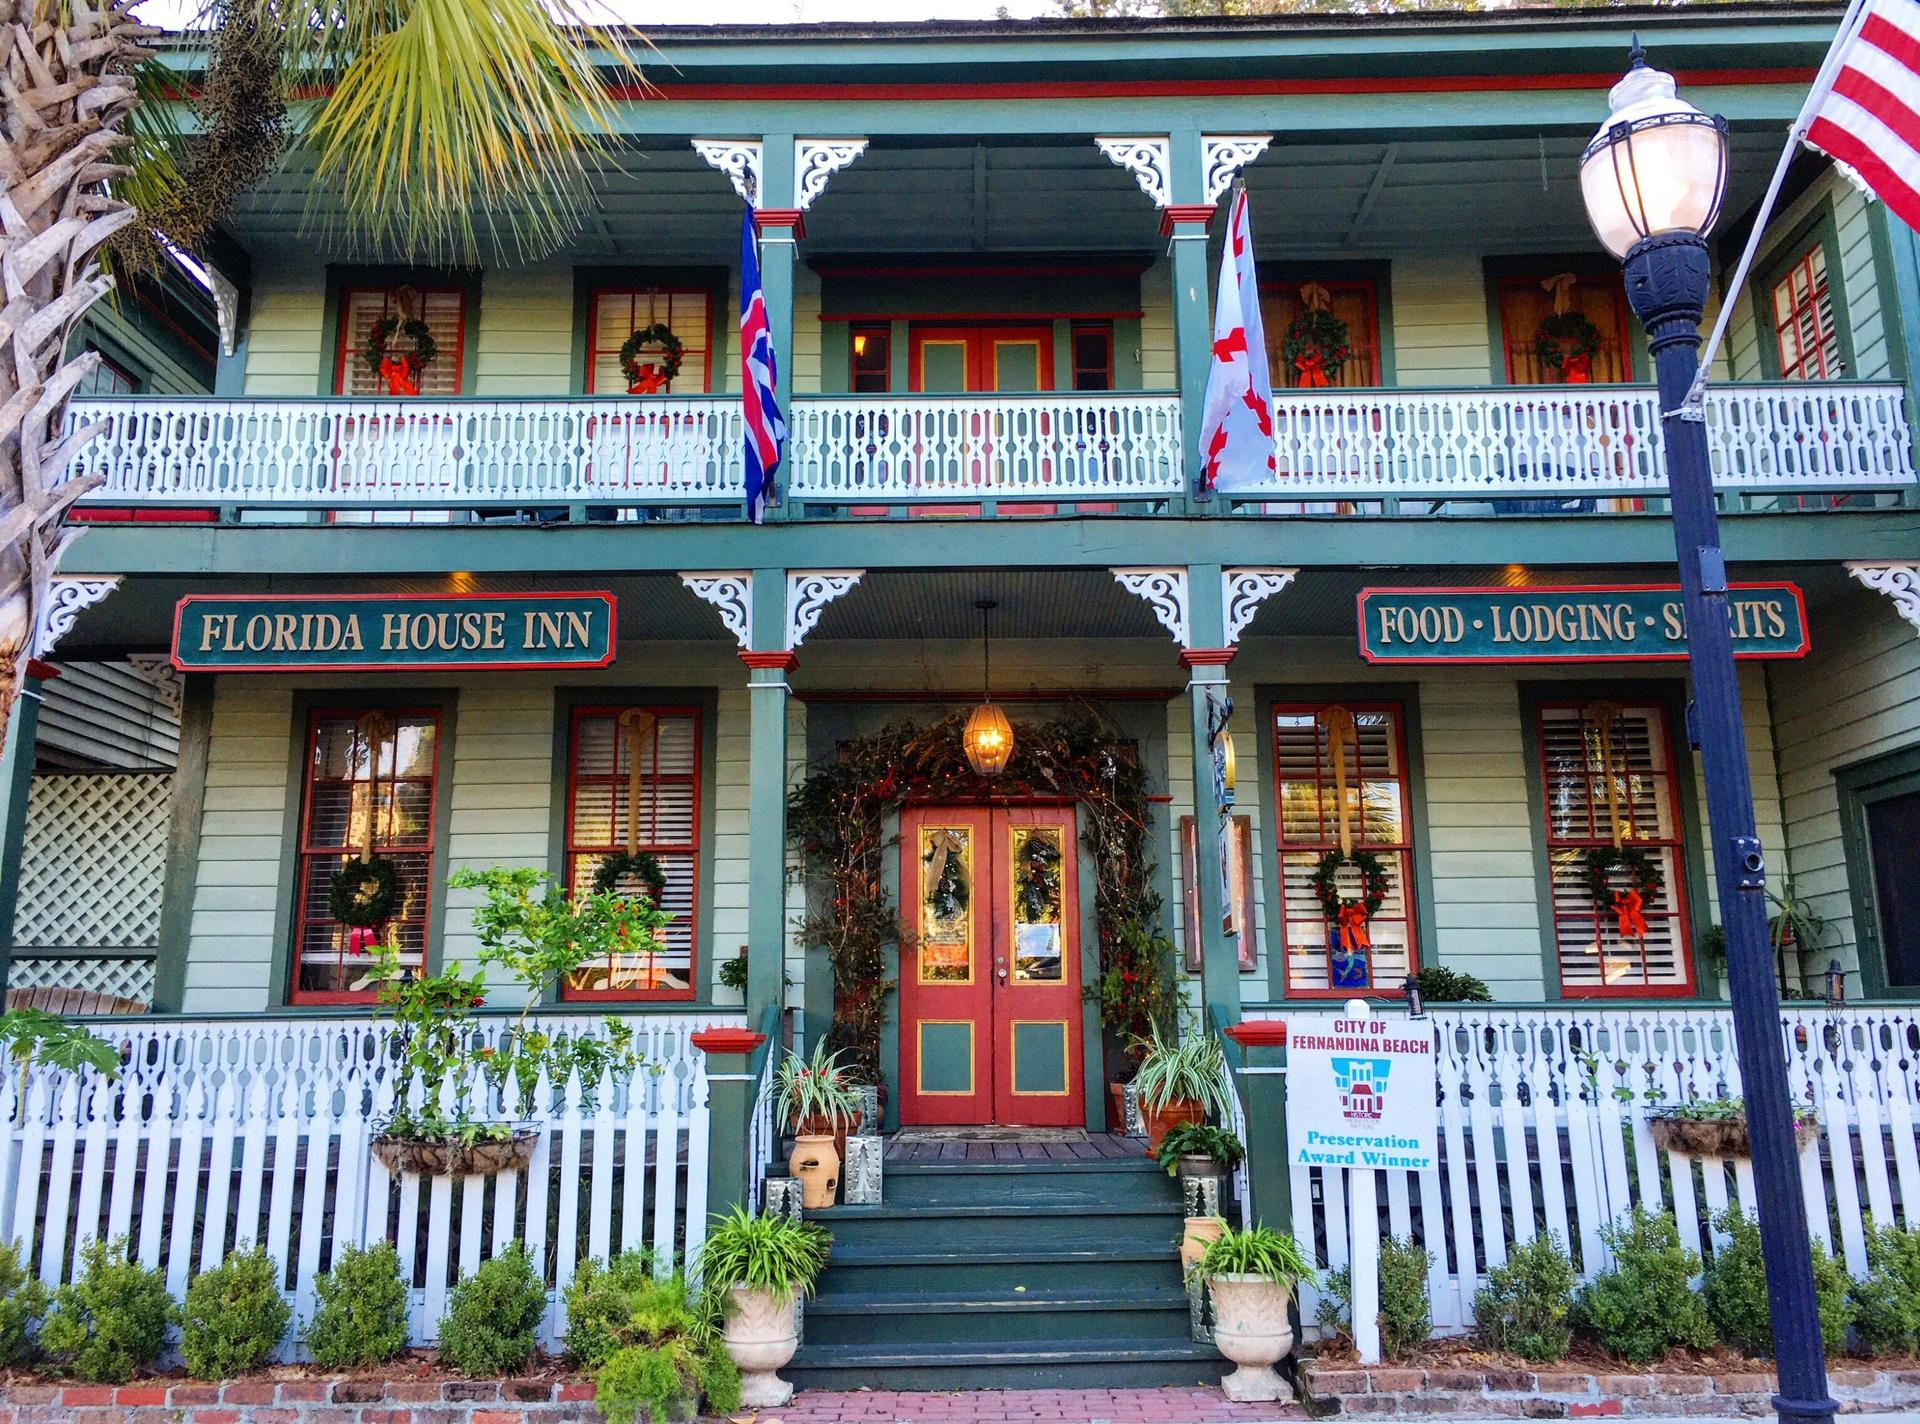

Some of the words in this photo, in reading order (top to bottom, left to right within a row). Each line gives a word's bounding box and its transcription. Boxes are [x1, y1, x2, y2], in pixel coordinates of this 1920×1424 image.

[1378, 606, 1465, 643] FOOD
[1490, 603, 1637, 642] LODGING
[1662, 600, 1786, 640] SITS
[200, 614, 364, 652] FLORIDA
[380, 612, 506, 650] HOUSE
[522, 611, 593, 649] INN
[1334, 1019, 1366, 1034] CITY
[1369, 1021, 1387, 1035] OF
[1292, 1035, 1380, 1052] FERNANDINA
[1383, 1039, 1429, 1054] BEACH
[1307, 1131, 1419, 1149] Preservation
[1298, 1149, 1355, 1165] Award
[1361, 1153, 1430, 1168] Winner
